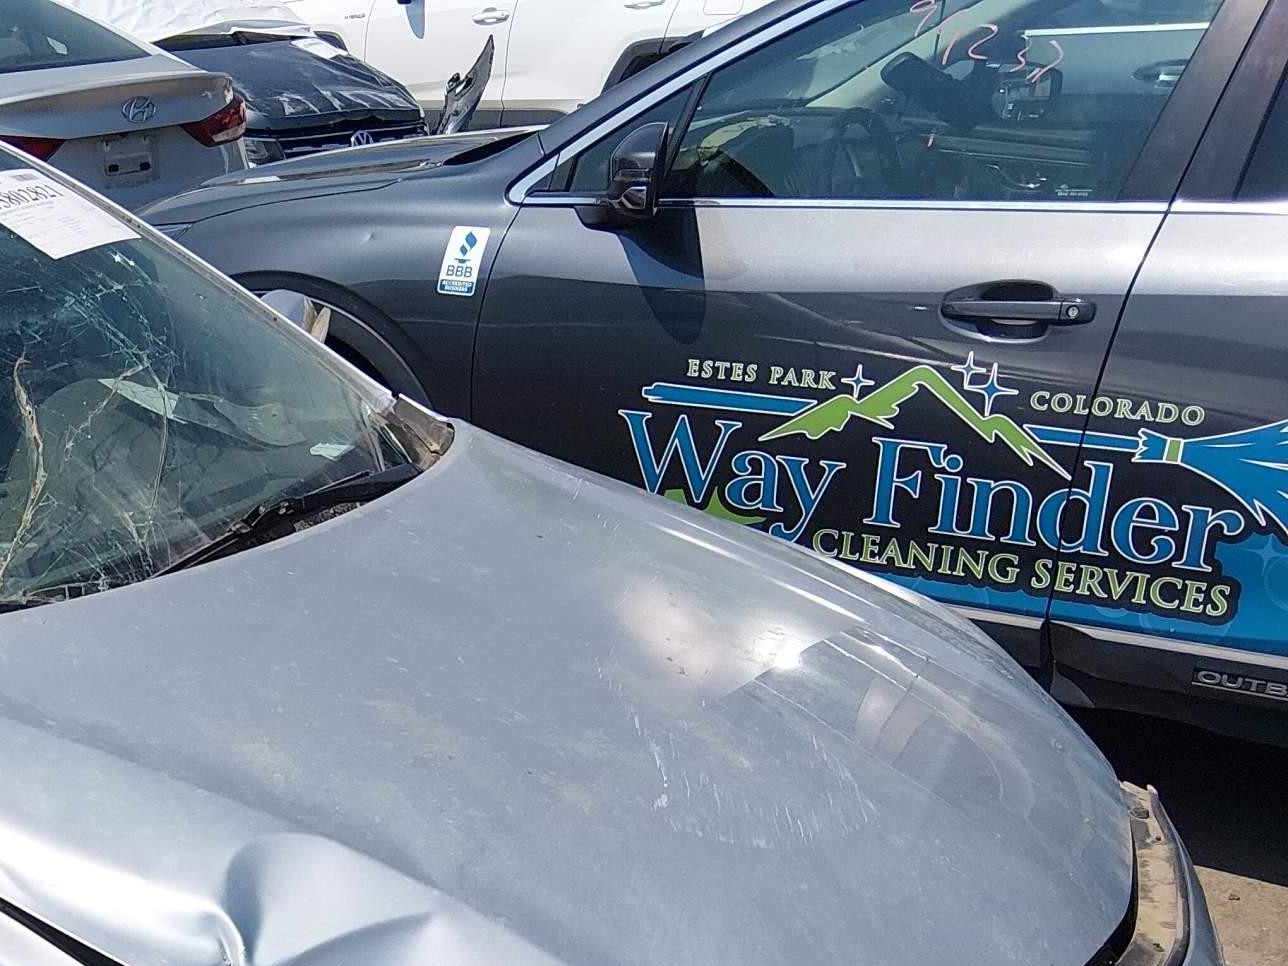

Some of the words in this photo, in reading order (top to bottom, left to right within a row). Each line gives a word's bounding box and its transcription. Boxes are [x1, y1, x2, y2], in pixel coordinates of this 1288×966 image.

[446, 265, 473, 277] BBB
[687, 359, 757, 384] ESTES
[770, 366, 836, 390] PARK
[1030, 390, 1206, 426] COLORADO
[618, 409, 846, 543] Way
[864, 436, 1244, 573] Finder
[812, 528, 1019, 584] CLEANING
[1033, 559, 1230, 618] SERVICES
[1197, 671, 1288, 697] OUTB
